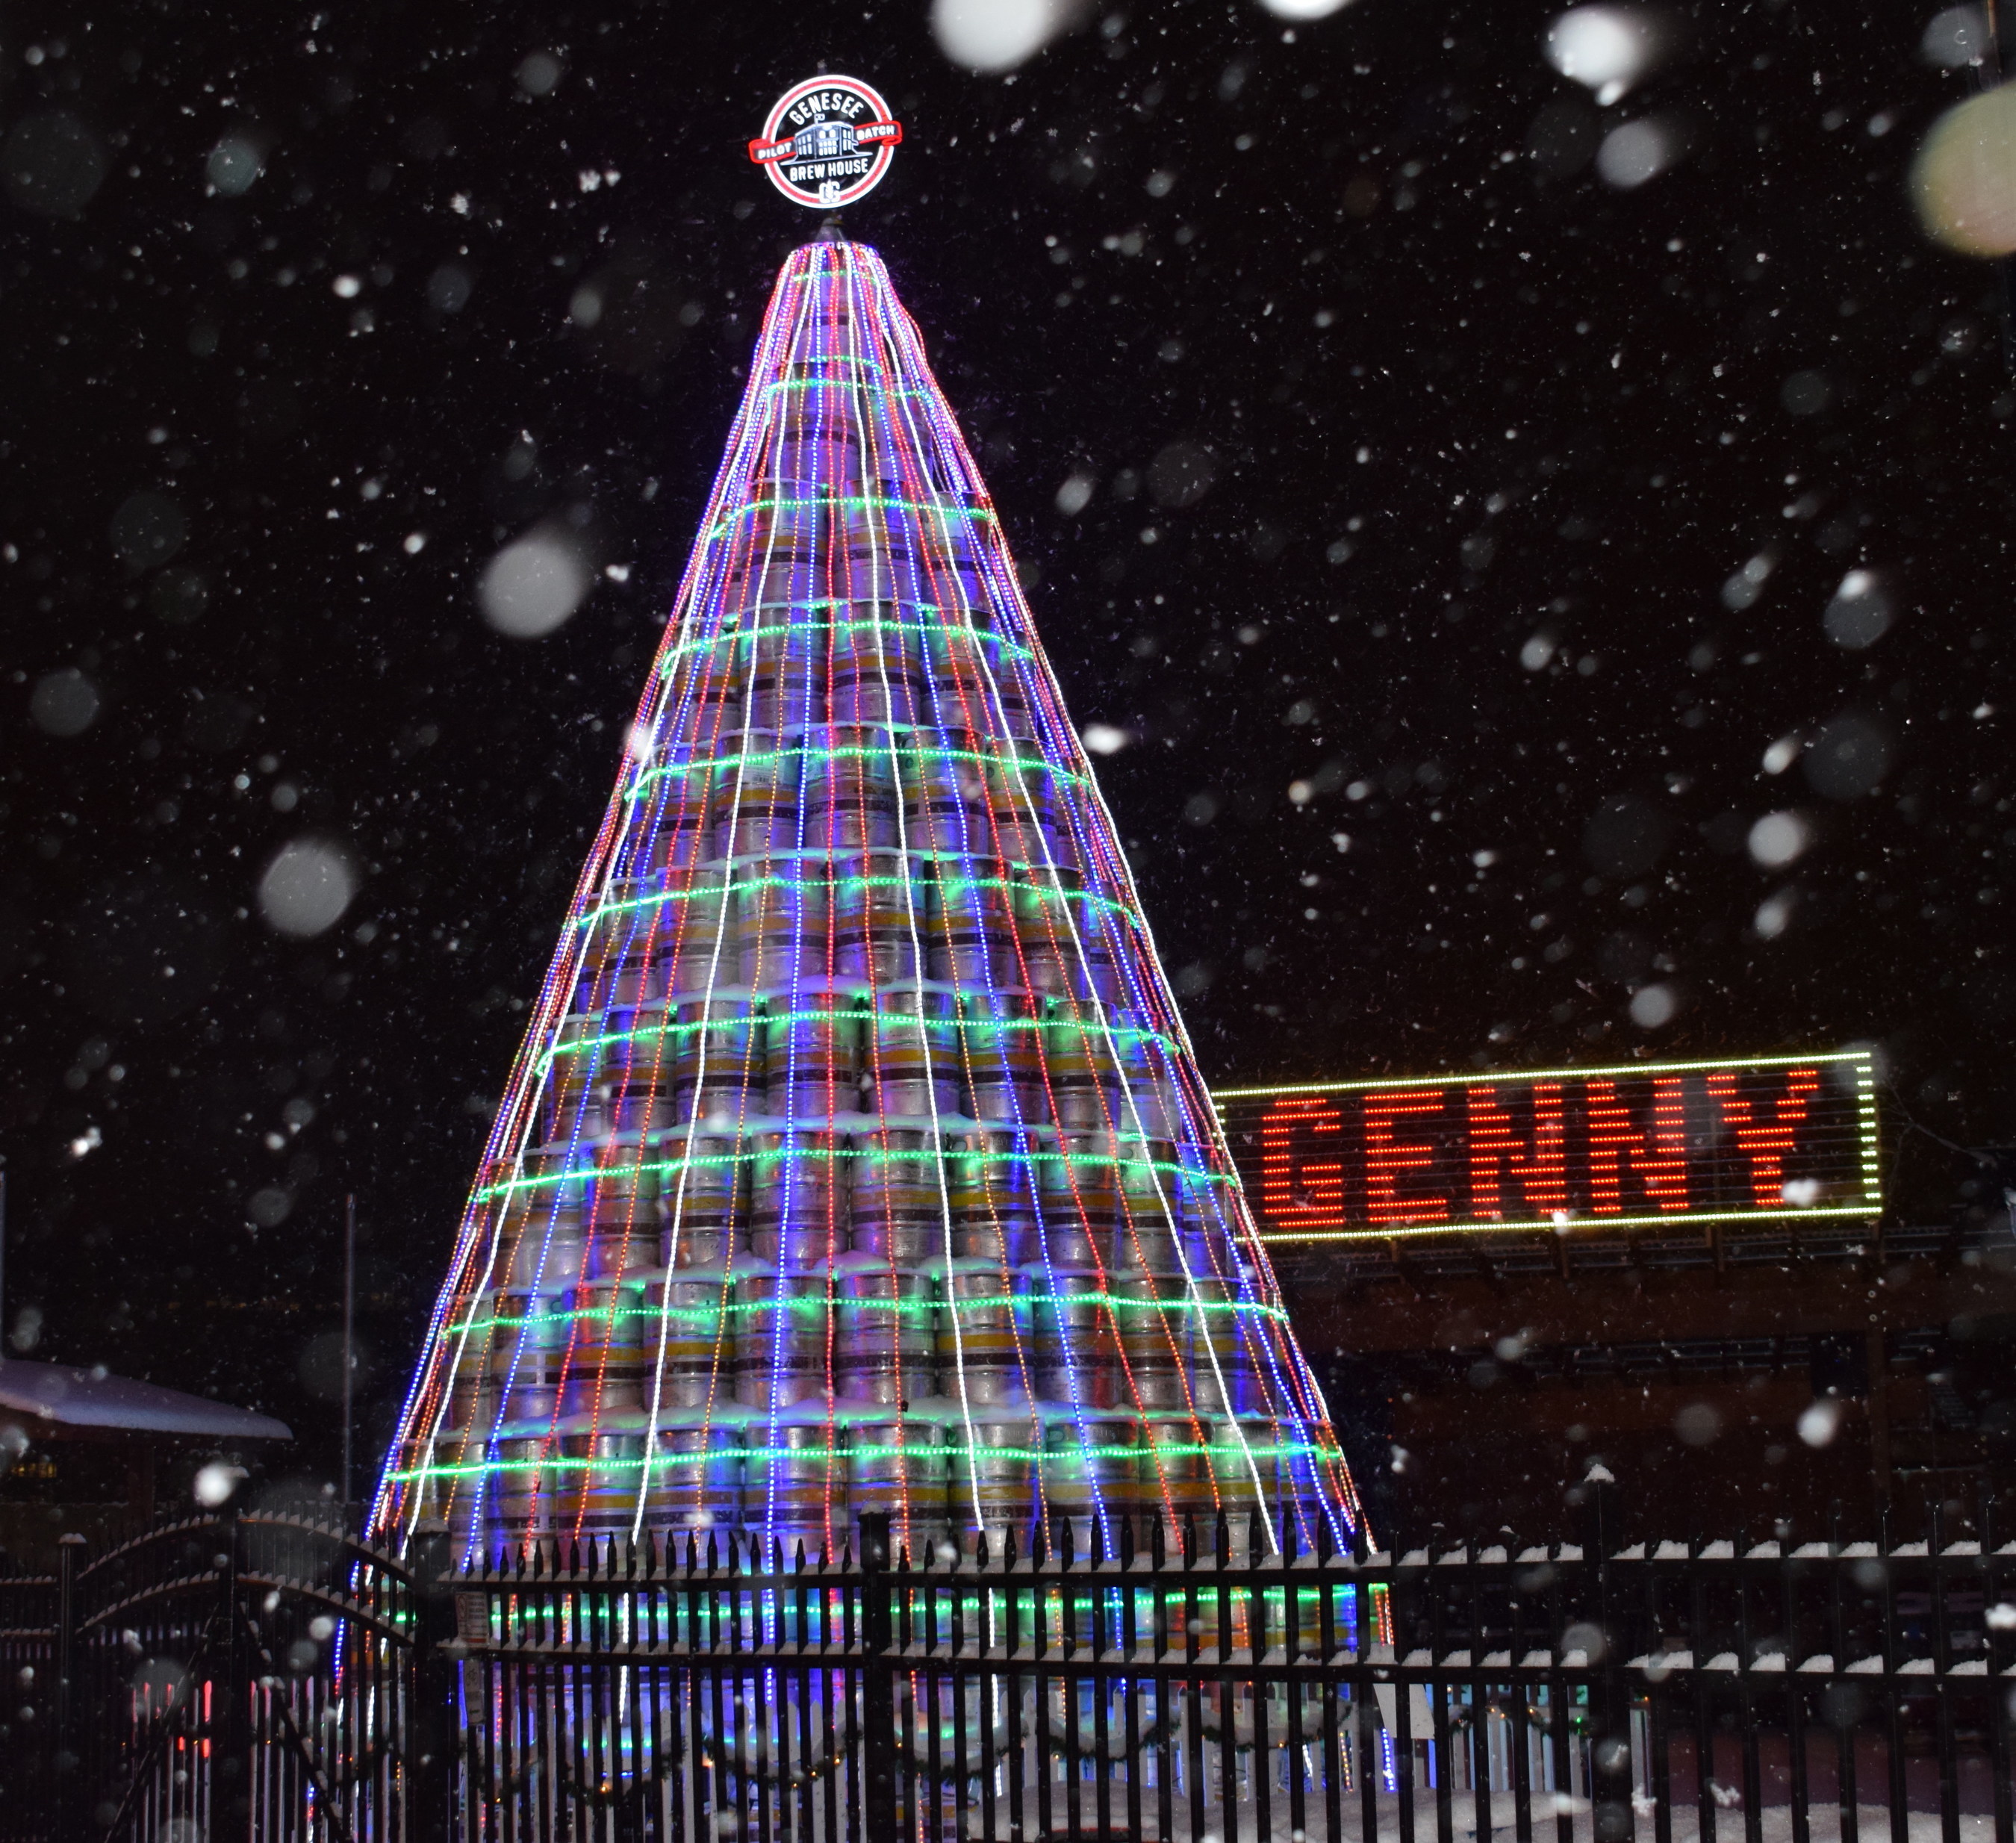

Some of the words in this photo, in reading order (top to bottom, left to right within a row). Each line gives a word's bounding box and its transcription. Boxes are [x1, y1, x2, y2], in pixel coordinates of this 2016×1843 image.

[788, 93, 865, 125] GENESEE
[758, 142, 792, 160] PILOT
[856, 125, 895, 141] BATCH
[789, 163, 826, 182] BREW
[827, 158, 869, 177] HOUSE
[1261, 1069, 1820, 1227] GENNY
